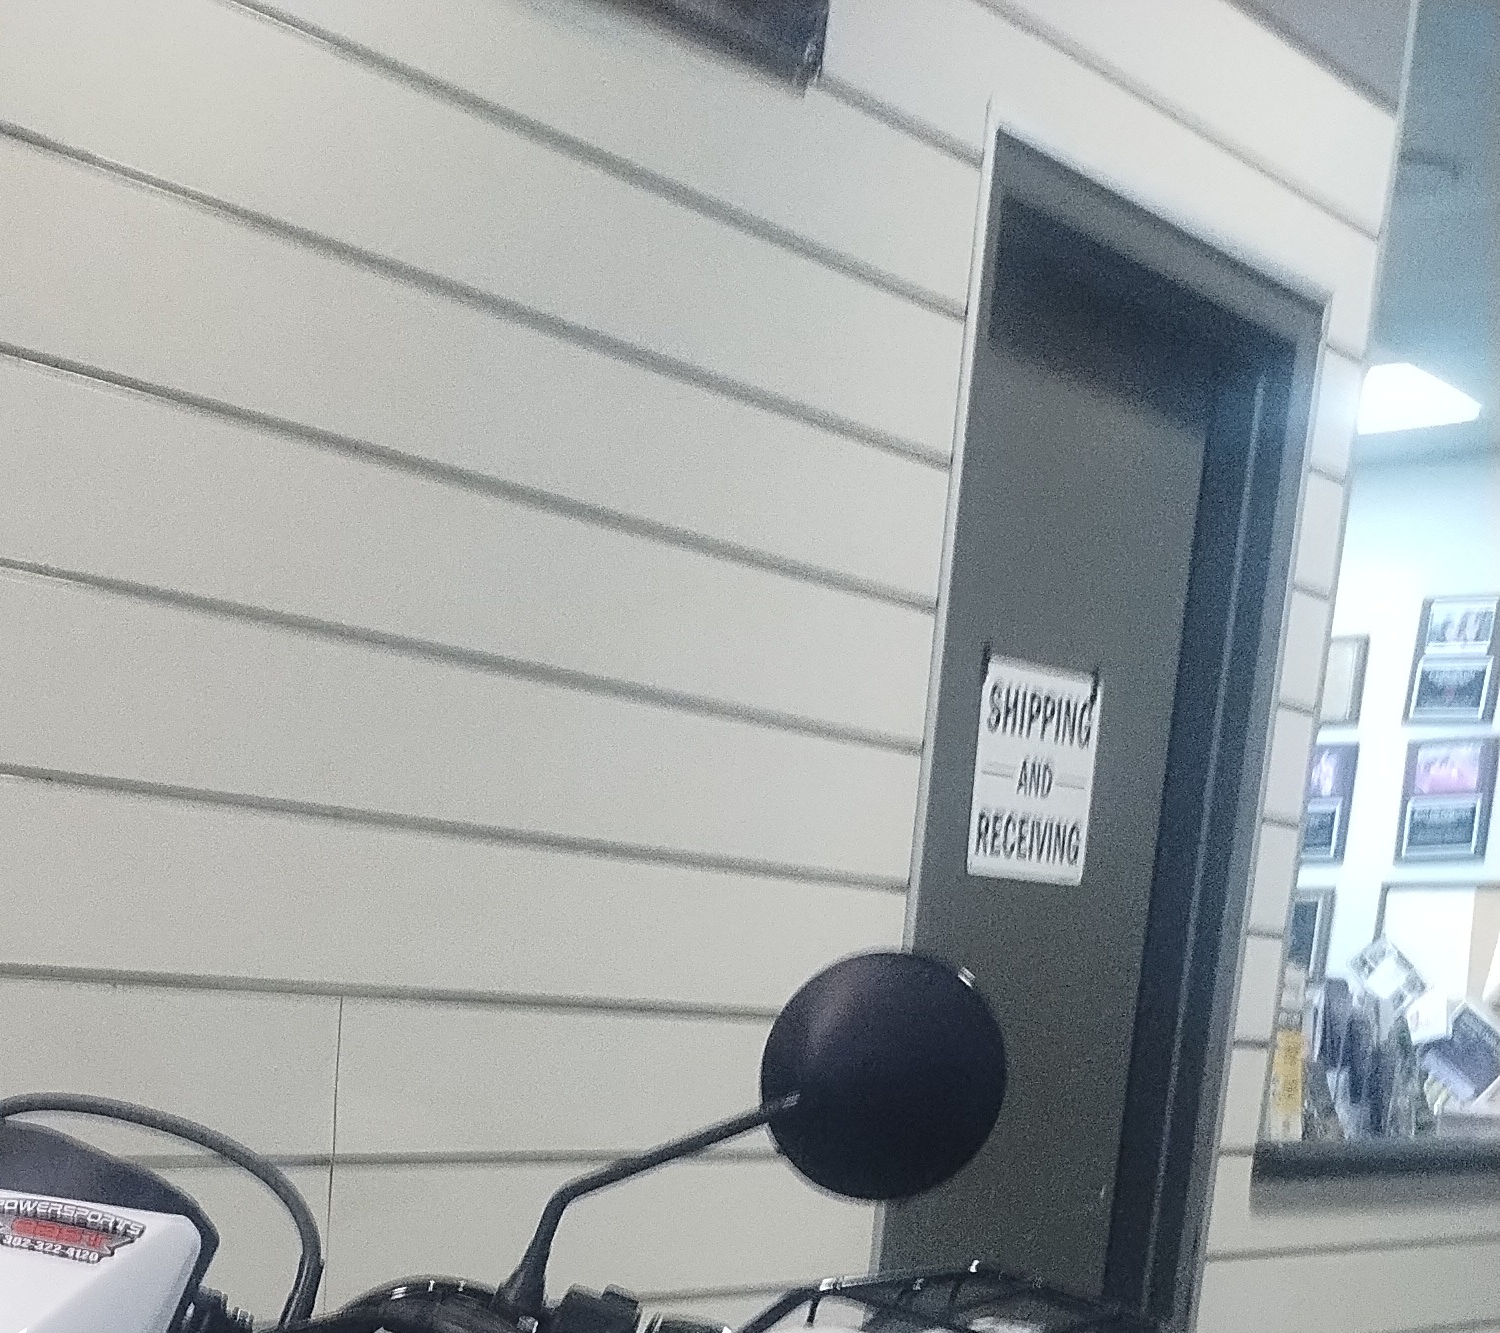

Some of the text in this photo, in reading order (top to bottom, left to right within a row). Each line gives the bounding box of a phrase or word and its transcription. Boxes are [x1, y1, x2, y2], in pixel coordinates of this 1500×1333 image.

[986, 679, 1094, 750] SHIPPING
[1016, 756, 1053, 798] AND
[975, 809, 1080, 866] RECEIVING
[2, 1234, 100, 1263] 302-322-4120
